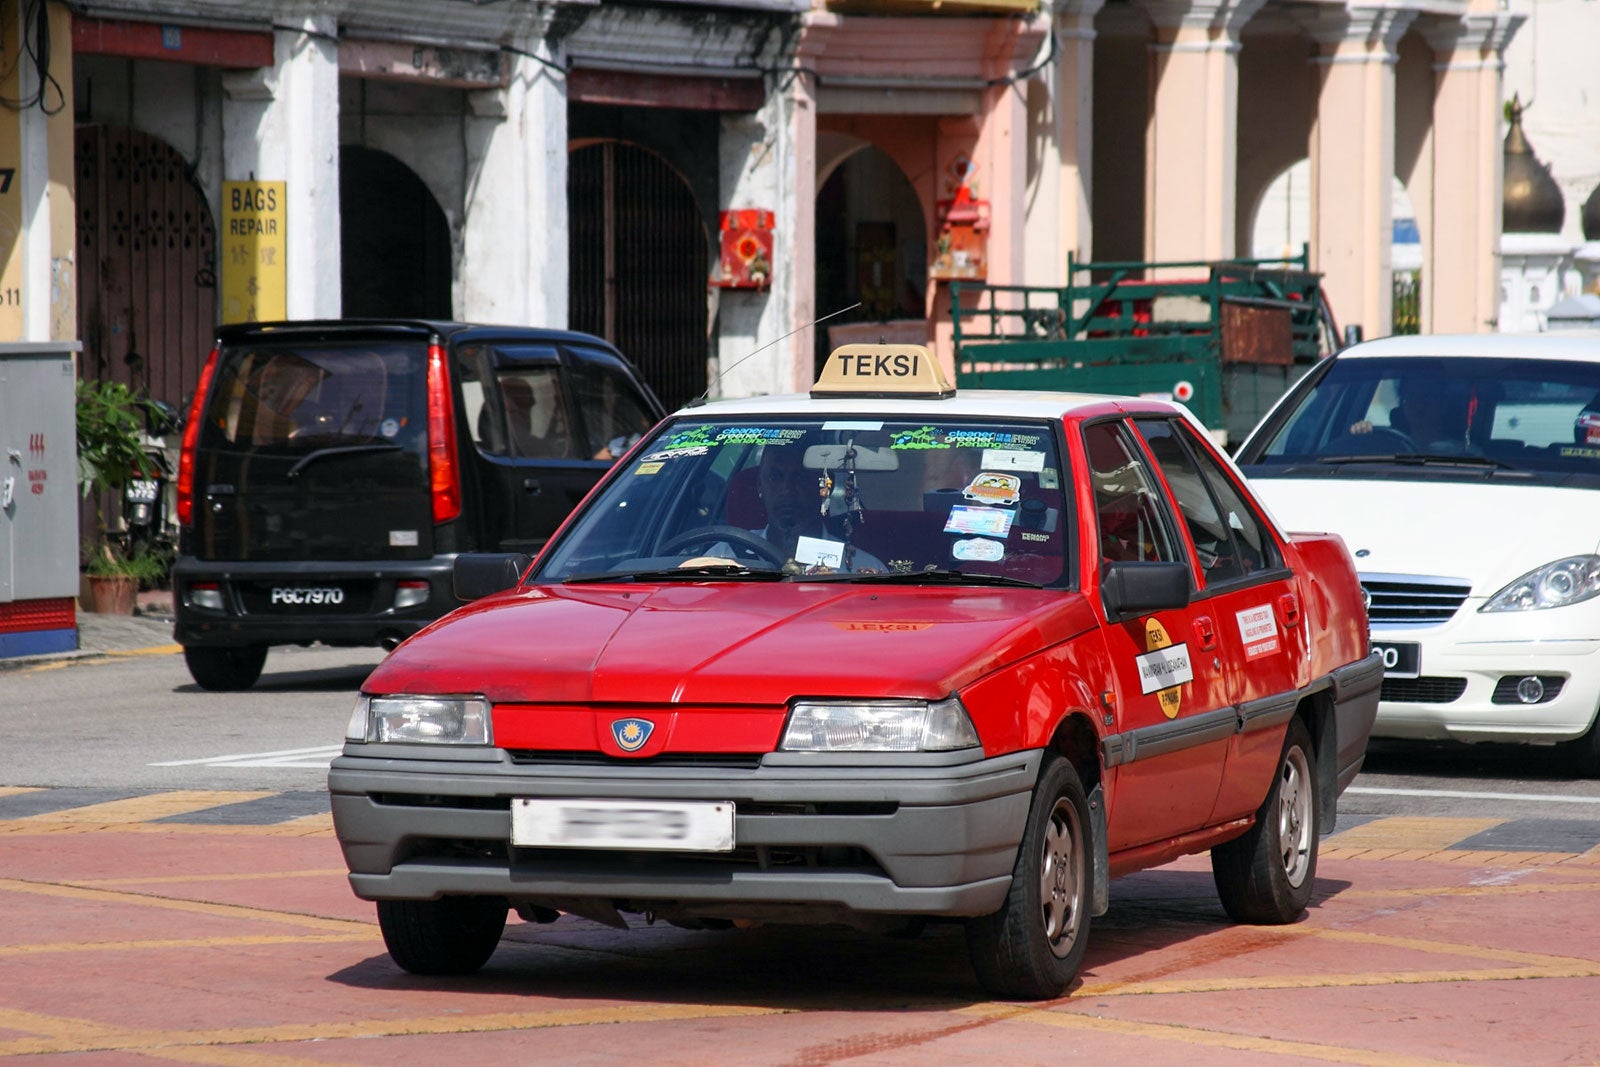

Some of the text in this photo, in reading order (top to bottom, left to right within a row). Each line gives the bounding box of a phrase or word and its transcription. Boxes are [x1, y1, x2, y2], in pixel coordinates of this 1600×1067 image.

[231, 188, 276, 212] BAGS
[230, 219, 277, 235] REPAIR
[837, 354, 919, 377] TEKSI
[956, 441, 1002, 449] penang
[271, 588, 344, 605] PGC7970
